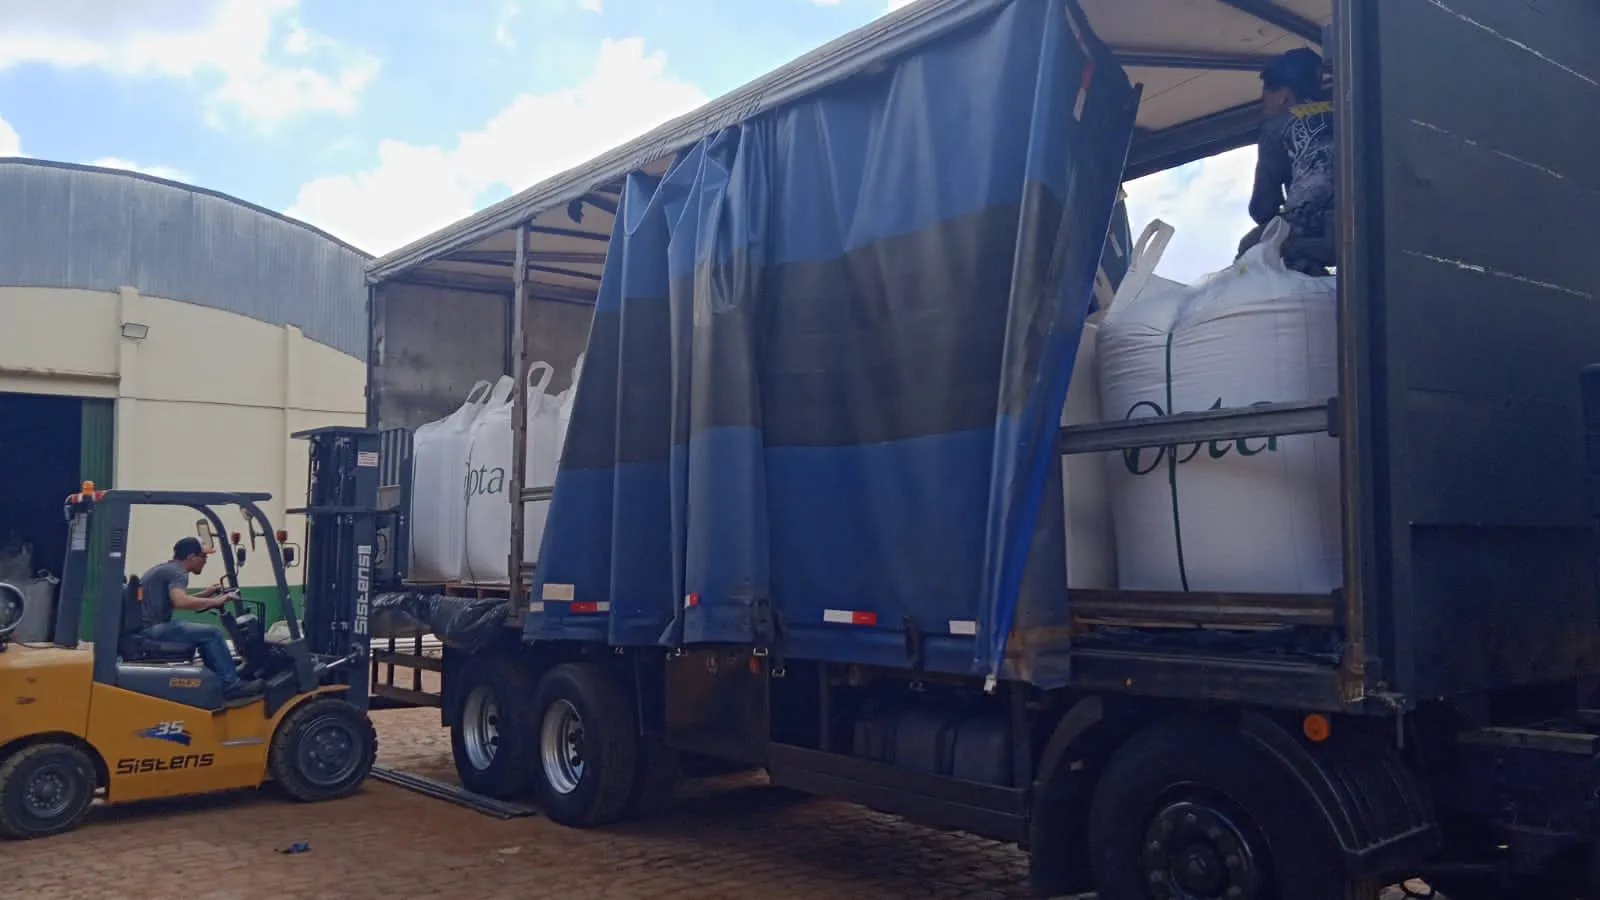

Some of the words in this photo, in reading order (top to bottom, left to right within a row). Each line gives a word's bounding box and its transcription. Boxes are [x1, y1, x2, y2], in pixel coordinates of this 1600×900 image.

[464, 464, 504, 496] pta
[353, 555, 370, 635] Sistens
[158, 720, 184, 735] 35
[116, 753, 214, 775] Sistens
